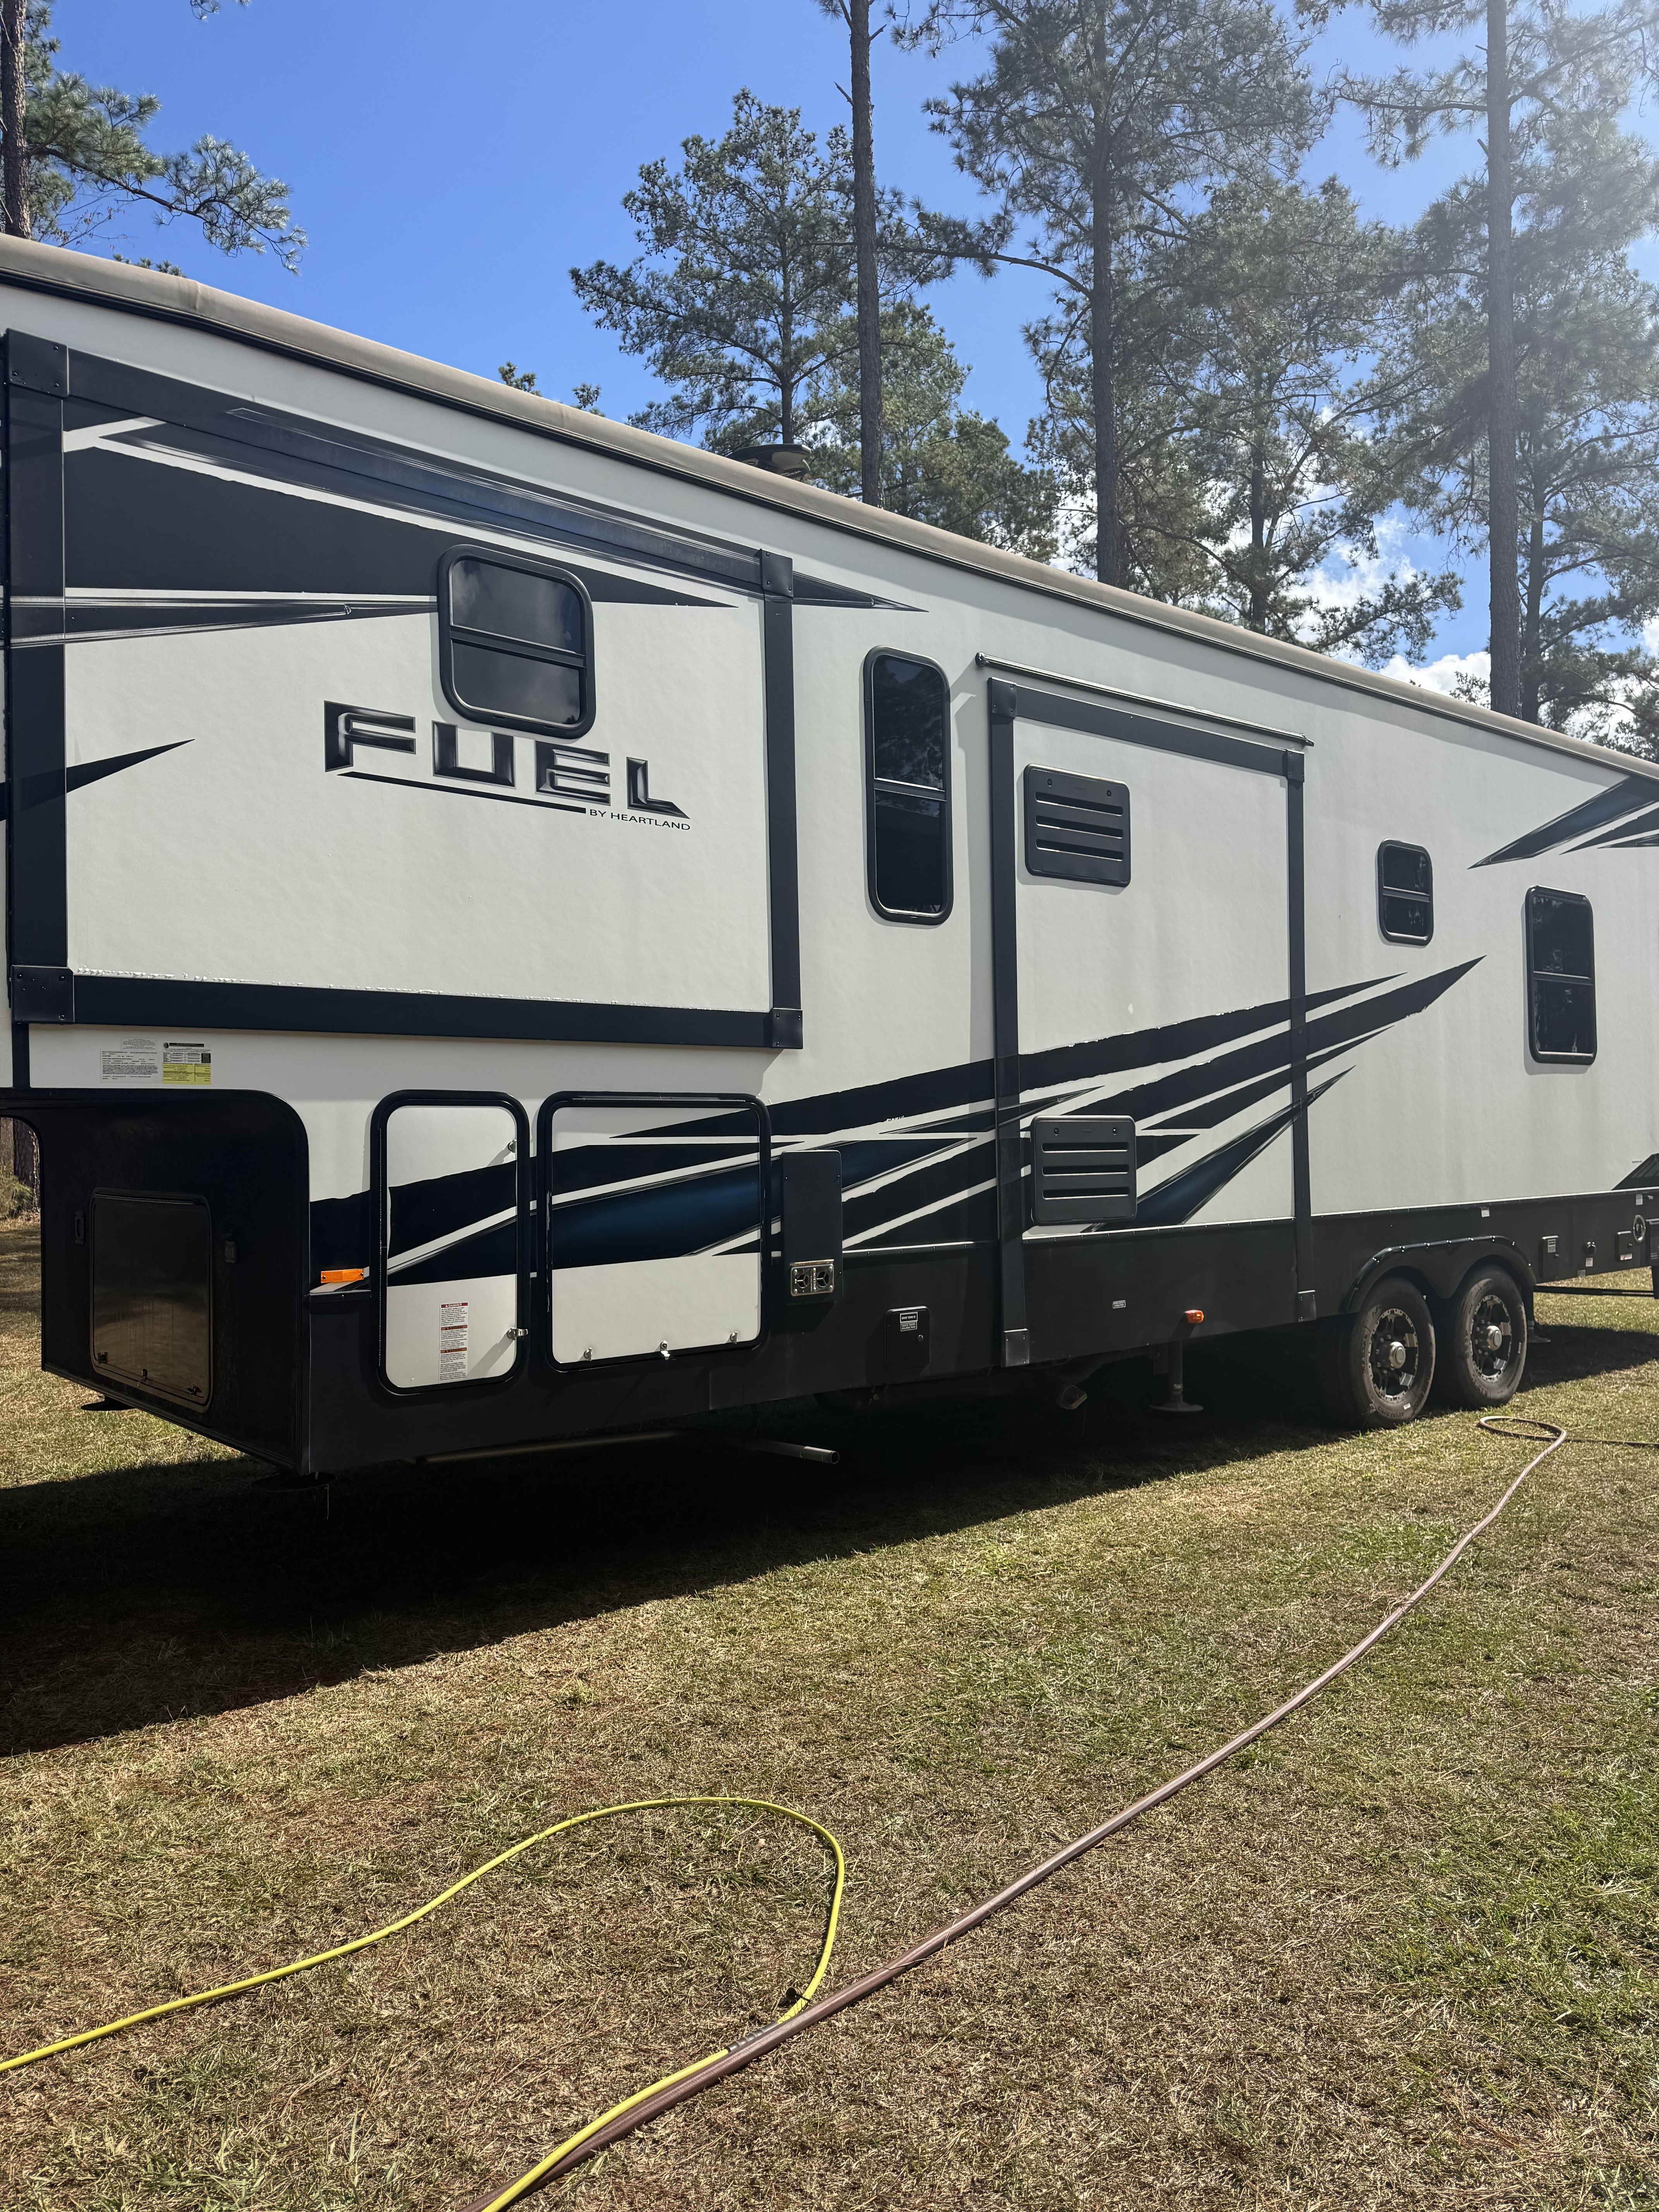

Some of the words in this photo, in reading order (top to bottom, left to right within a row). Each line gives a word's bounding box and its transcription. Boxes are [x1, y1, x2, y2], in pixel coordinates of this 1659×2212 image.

[324, 700, 690, 819] FUEL
[589, 809, 606, 817] BY
[611, 812, 690, 830] HEARTLAND
